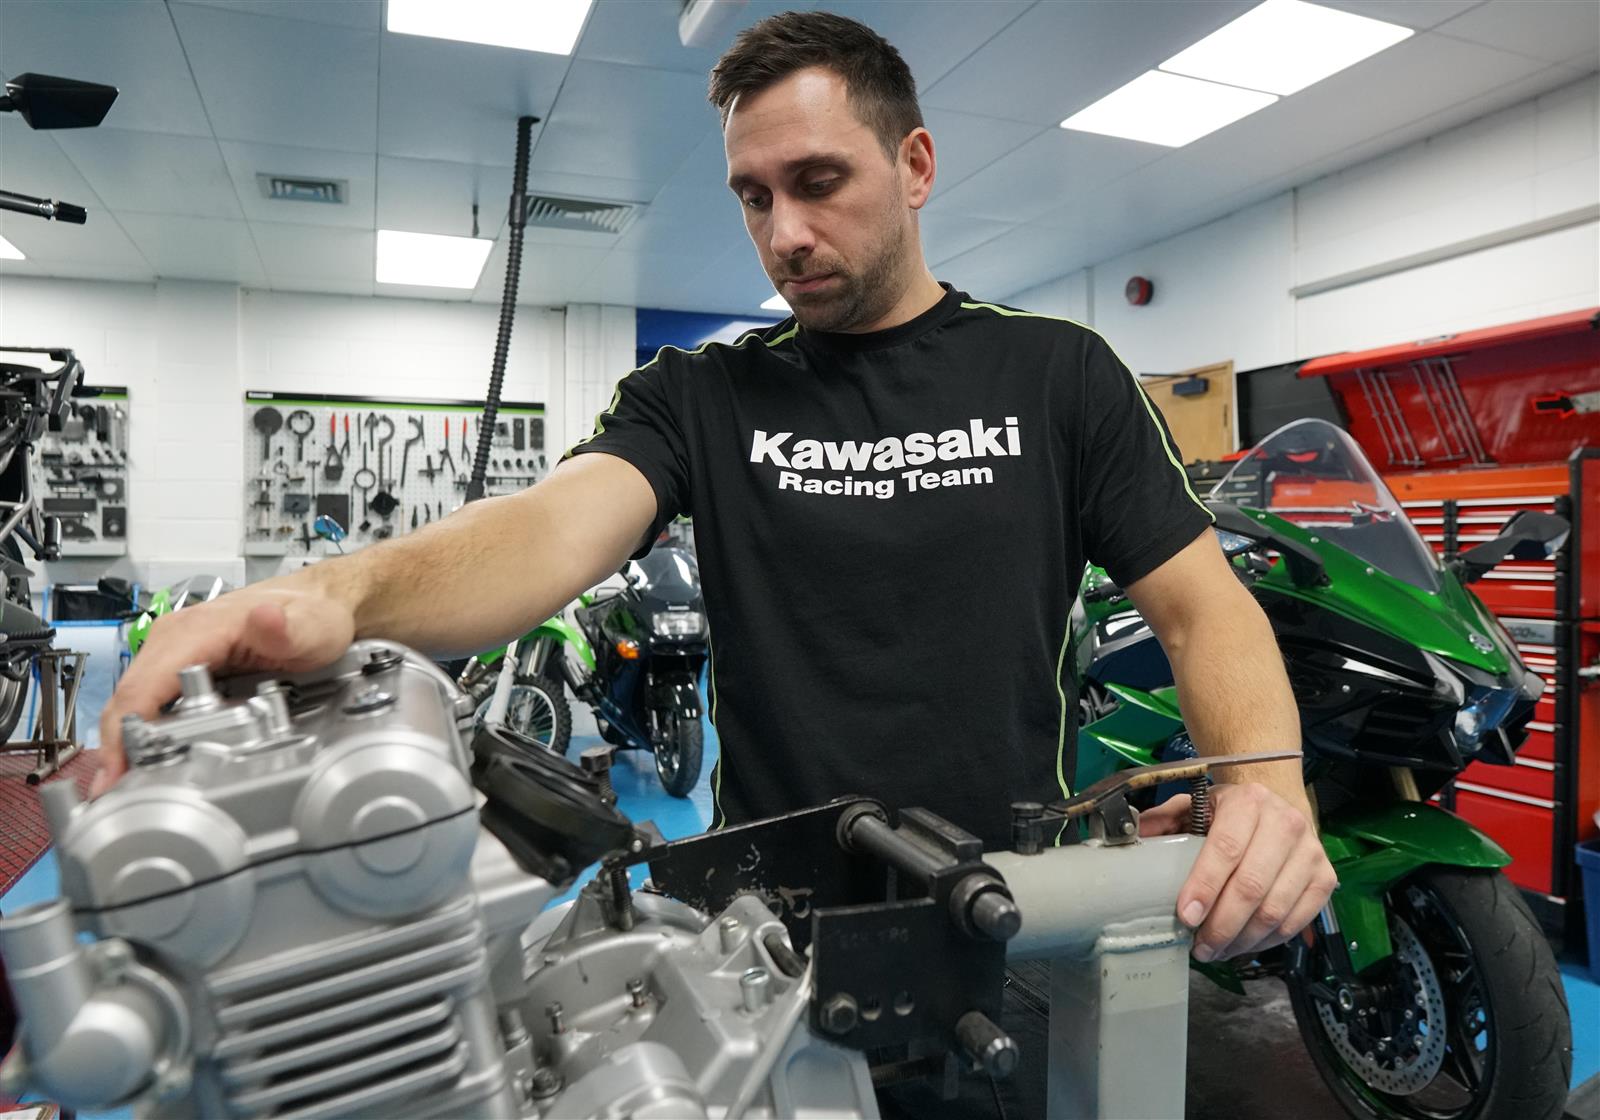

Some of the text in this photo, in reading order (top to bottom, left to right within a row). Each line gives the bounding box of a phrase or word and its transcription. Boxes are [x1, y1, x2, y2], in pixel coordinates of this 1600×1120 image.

[750, 416, 1022, 472] Kawasaki
[778, 466, 994, 499] Racing Team
